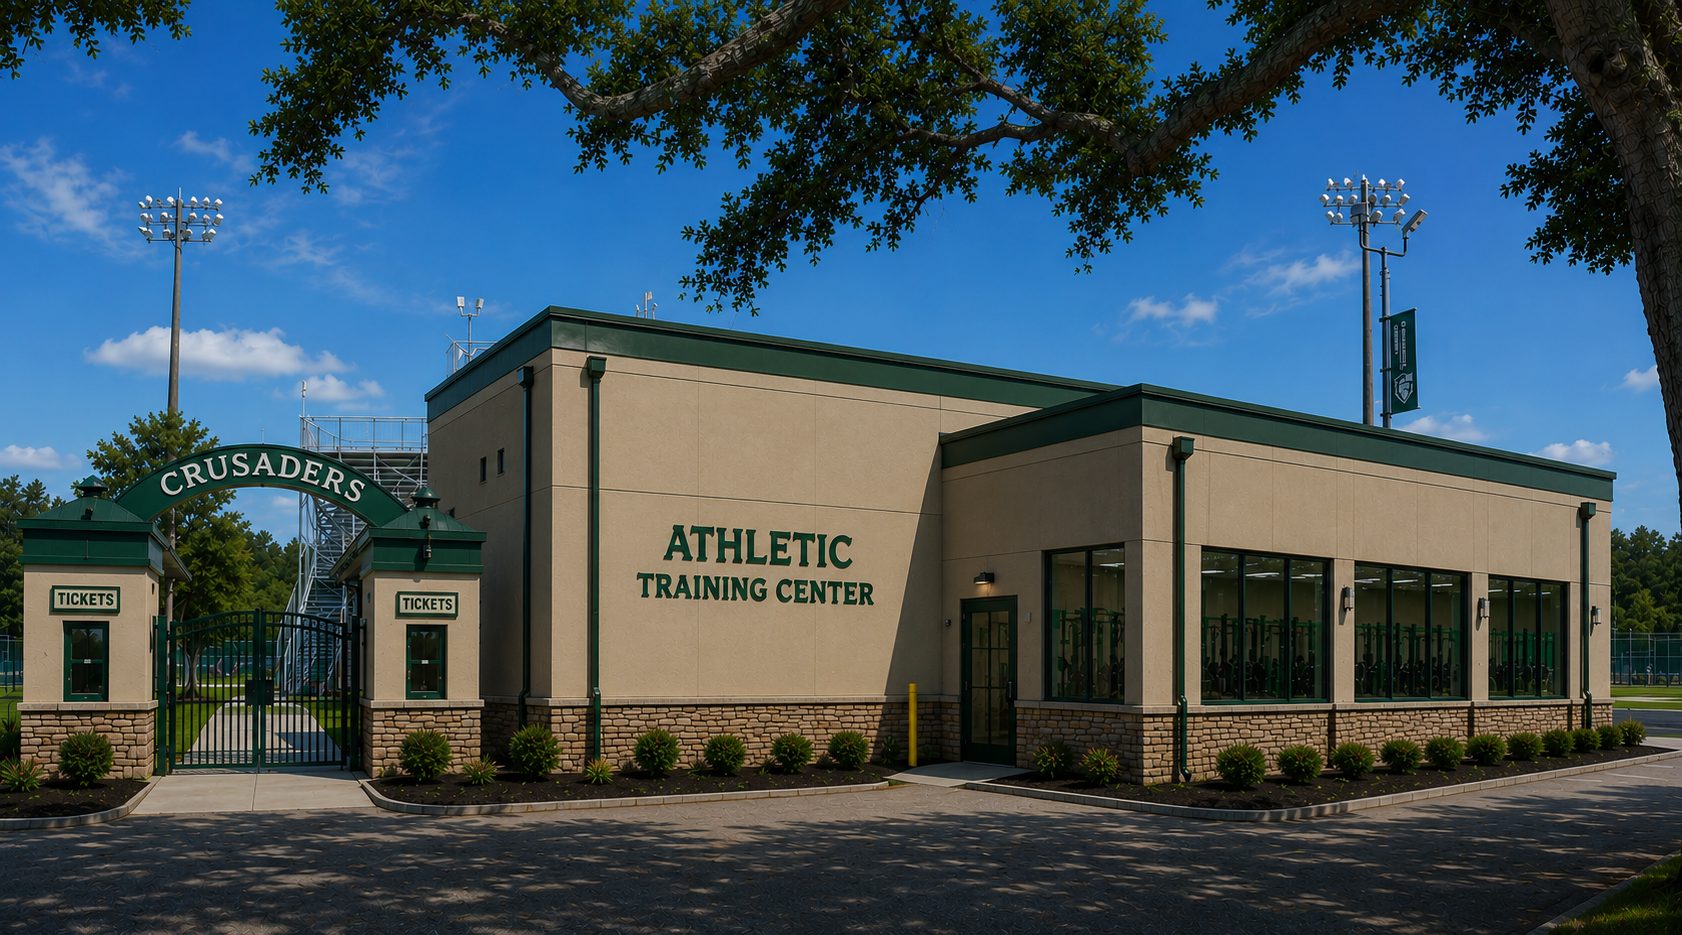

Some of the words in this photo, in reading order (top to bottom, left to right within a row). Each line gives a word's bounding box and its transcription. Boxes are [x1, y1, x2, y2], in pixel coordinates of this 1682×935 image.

[160, 452, 366, 503] CRUSADERS
[663, 524, 853, 569] ATHLETIC
[57, 592, 114, 606] TICKETS
[402, 597, 453, 611] TICKETS
[636, 572, 768, 602] TRAINING
[775, 578, 874, 606] CENTER
